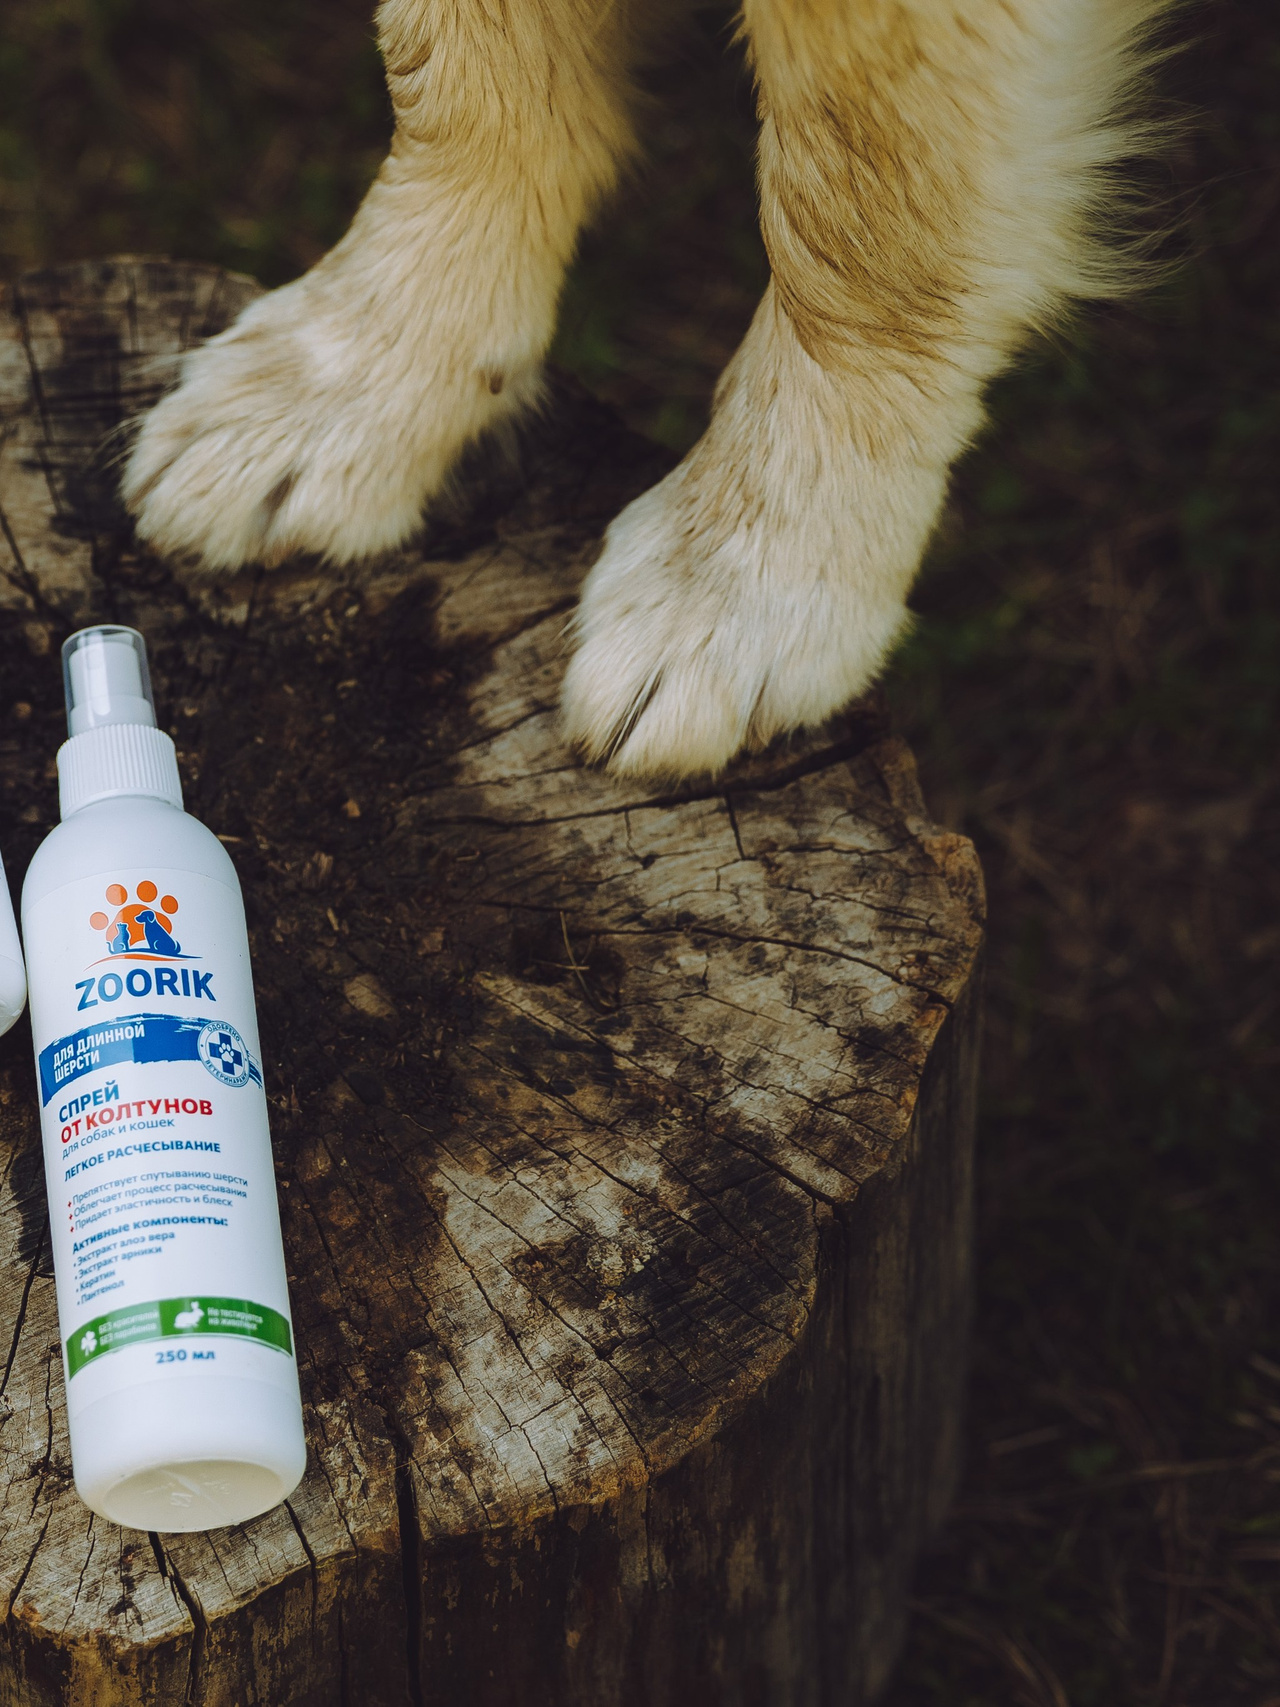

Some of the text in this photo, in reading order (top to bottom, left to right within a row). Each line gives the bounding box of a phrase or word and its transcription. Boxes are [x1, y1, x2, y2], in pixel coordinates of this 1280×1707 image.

[75, 967, 217, 1012] ZOORIK
[53, 1021, 145, 1070] ДЛЯ ДЛИННОЙ
[54, 1049, 100, 1084] ШЕРСТИ
[59, 1080, 120, 1123] СПРЕЙ
[61, 1098, 213, 1144] ОТ КОЛТУНОВ
[62, 1118, 175, 1160] для собак и кошек
[65, 1140, 221, 1182] ЛЕГКОЕ РАСЧЕСЫВАНИЕ
[72, 1170, 248, 1205] Препятствует спутыванию шерсти
[73, 1183, 247, 1217] Облегчает процесс расчесывания
[75, 1207, 112, 1230] Придает
[114, 1195, 191, 1213] эластичность
[202, 1194, 233, 1207] блеск
[72, 1215, 228, 1255] Активные компоненты:
[77, 1242, 118, 1266] Экстракт
[148, 1231, 175, 1241] вера
[78, 1255, 119, 1279] Экстракт
[155, 1349, 215, 1364] 250 мл
